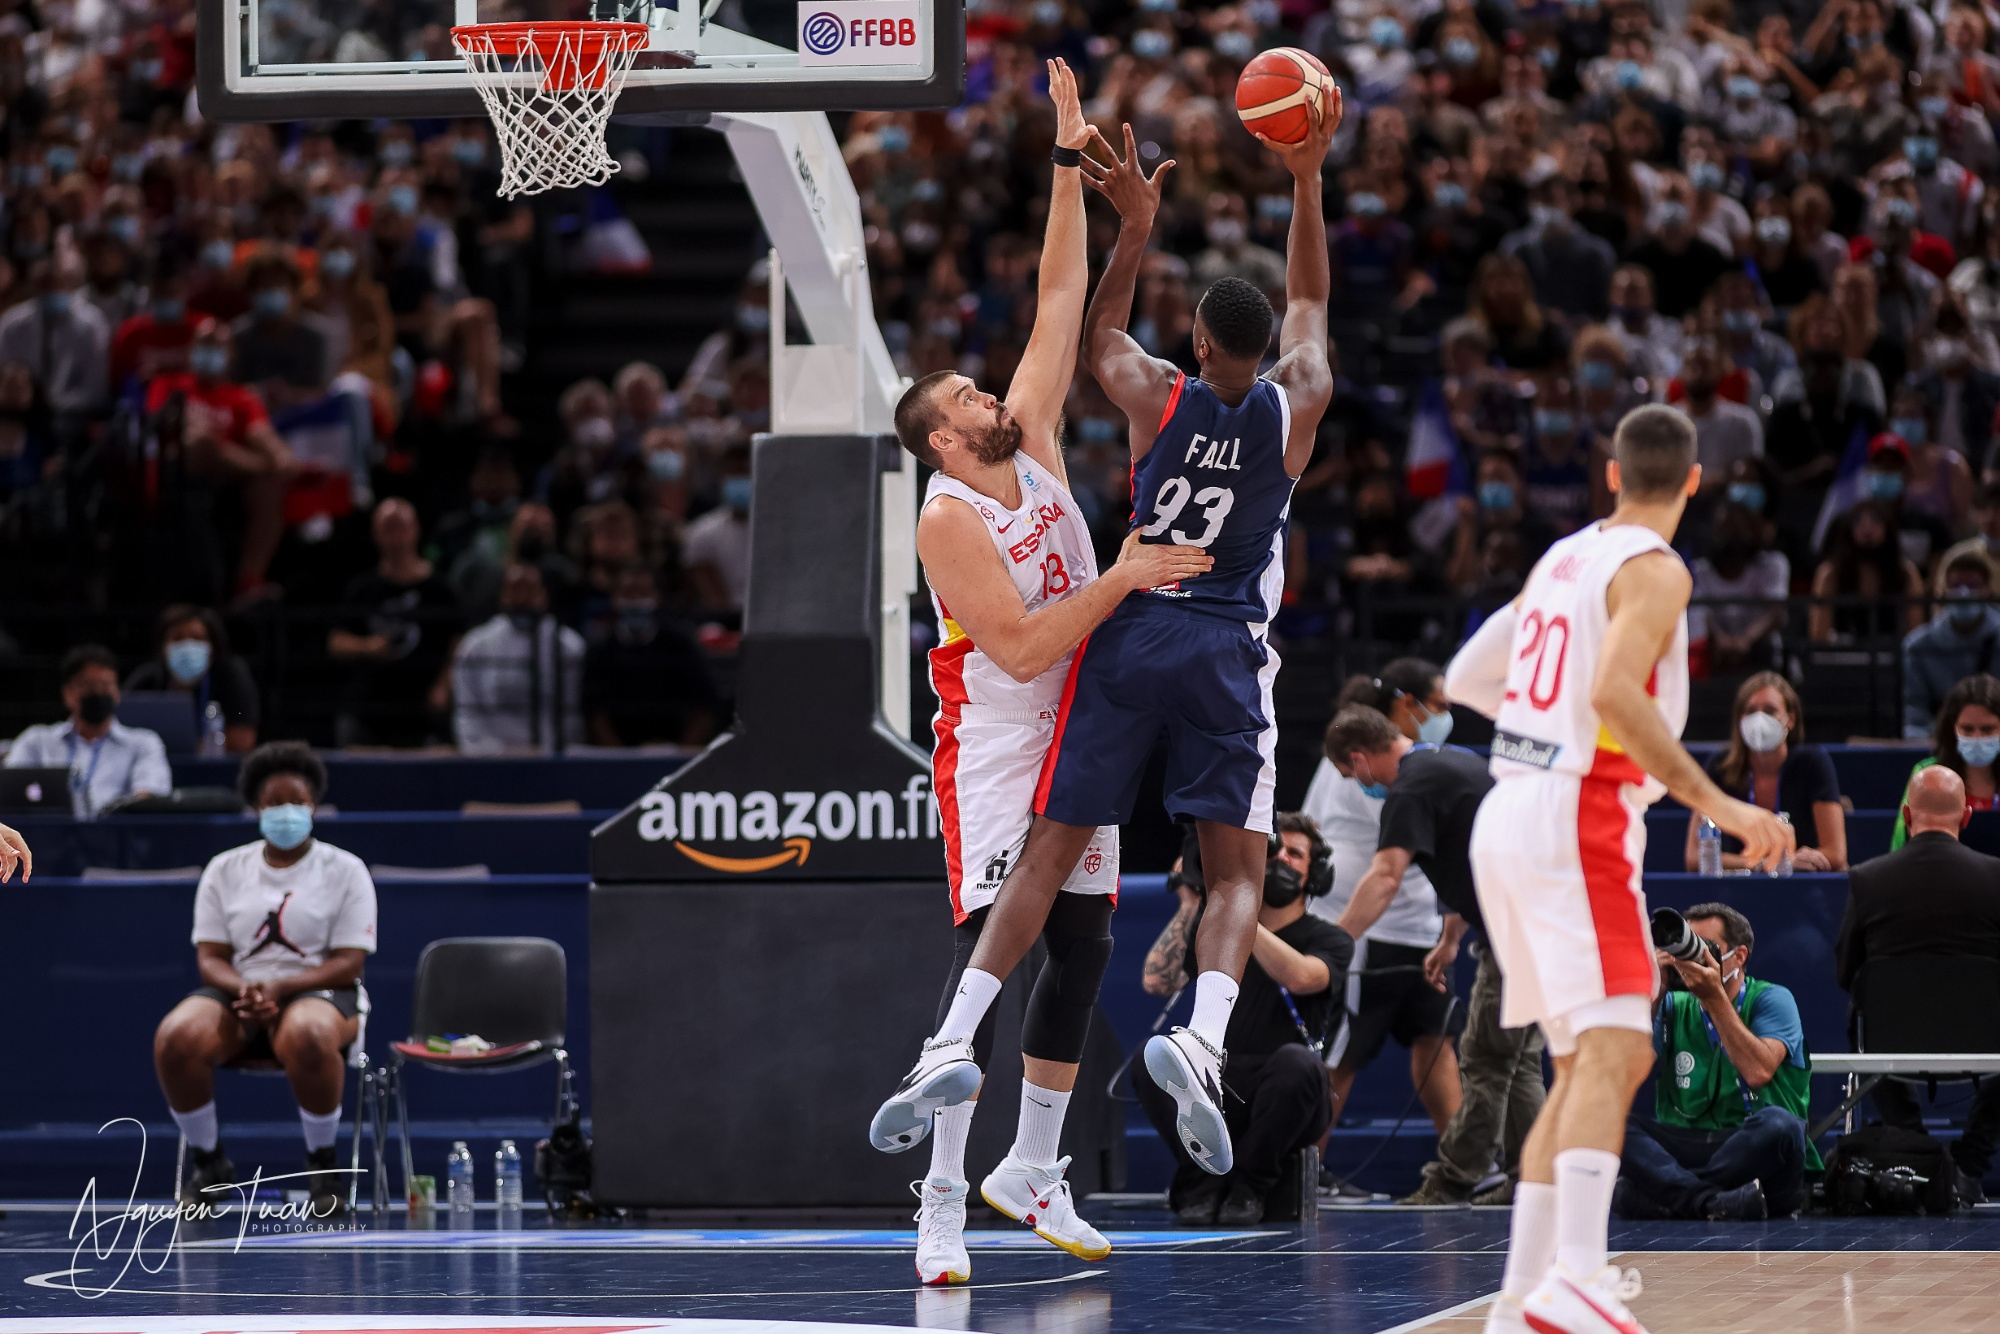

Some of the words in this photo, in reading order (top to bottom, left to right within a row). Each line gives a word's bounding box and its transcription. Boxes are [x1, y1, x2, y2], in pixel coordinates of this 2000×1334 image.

[850, 18, 917, 47] FFBB
[1184, 433, 1241, 471] FALL
[1140, 476, 1235, 548] 93
[1039, 553, 1070, 600] 13
[1504, 608, 1570, 712] 20
